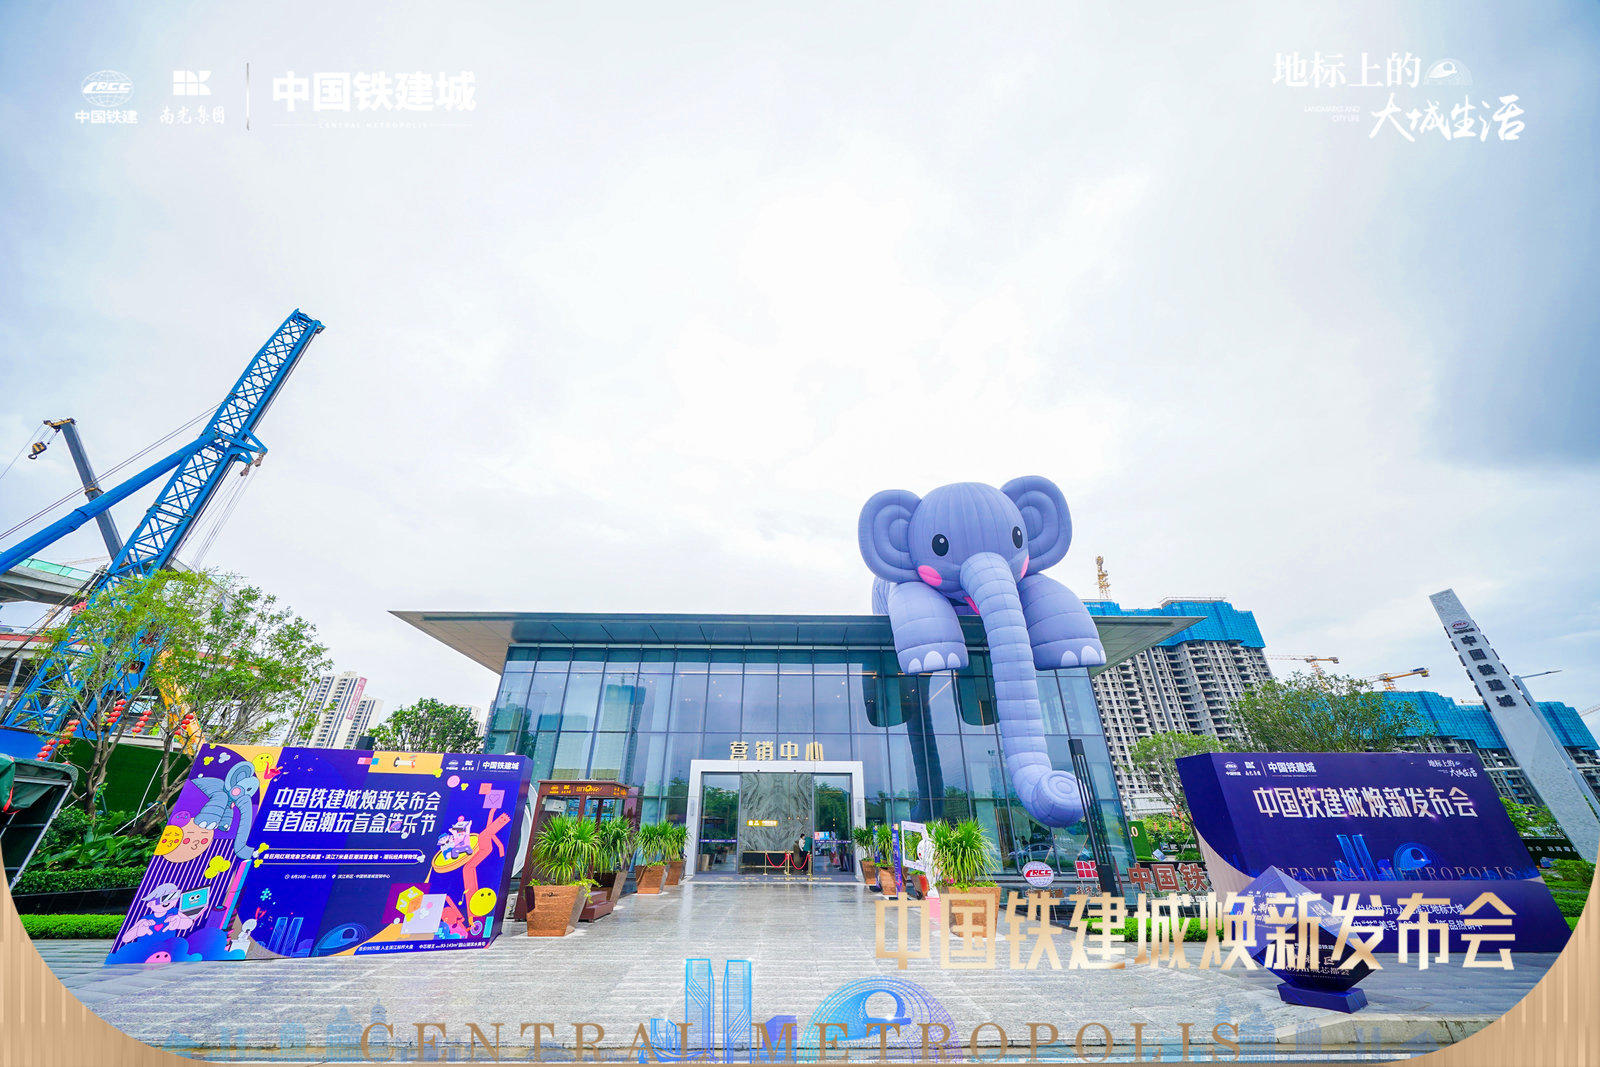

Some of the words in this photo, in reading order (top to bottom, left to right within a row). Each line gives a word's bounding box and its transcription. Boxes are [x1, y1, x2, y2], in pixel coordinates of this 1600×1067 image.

[730, 741, 823, 760] 营销中心
[1268, 762, 1317, 773] 中国铁建城
[273, 787, 441, 811] 中国铁建城焕新发布会
[1253, 787, 1478, 818] 中国铁建城焕新发布会
[1025, 869, 1052, 878] CRCC
